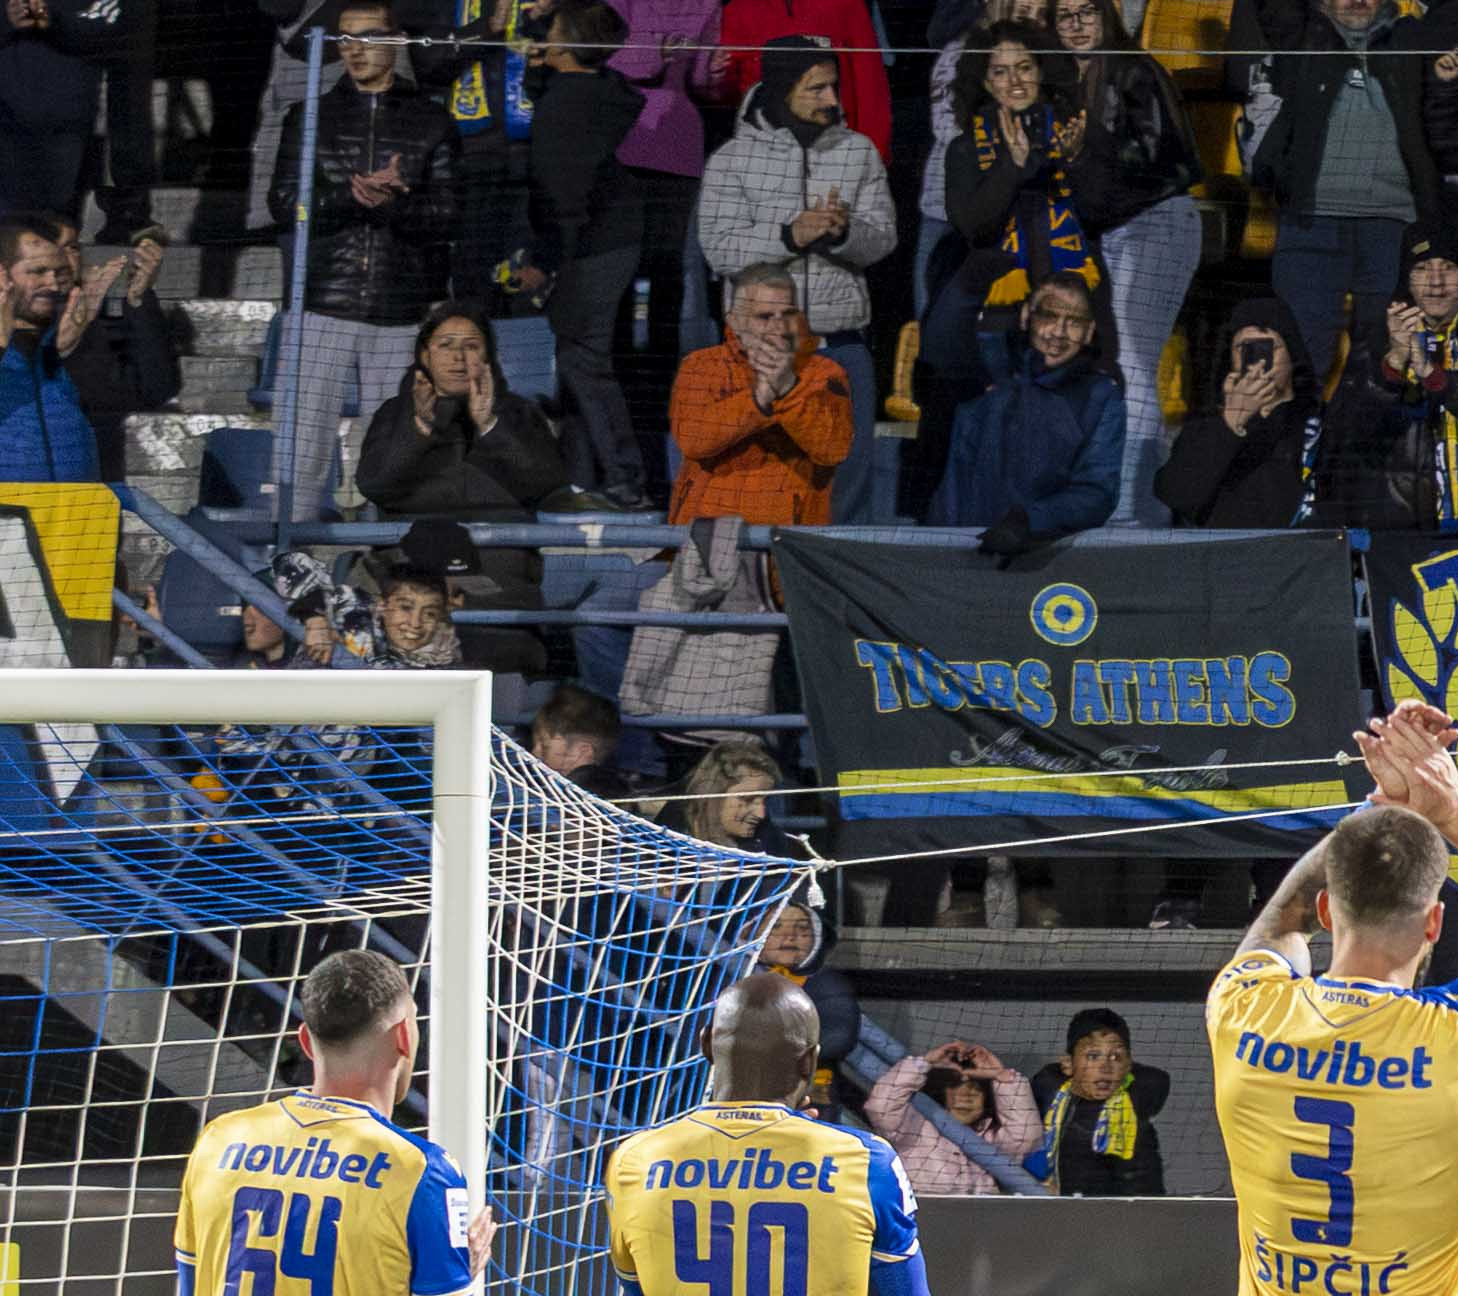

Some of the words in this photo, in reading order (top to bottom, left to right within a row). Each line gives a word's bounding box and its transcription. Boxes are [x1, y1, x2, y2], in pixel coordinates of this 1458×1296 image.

[855, 638, 1058, 729] TIGERS
[1070, 650, 1297, 729] ATHENS
[1322, 991, 1369, 1007] ASTERAS
[1236, 1031, 1433, 1090] novibet
[218, 1136, 393, 1189] novibet
[645, 1148, 839, 1194] novibet
[1291, 1096, 1355, 1247] 3
